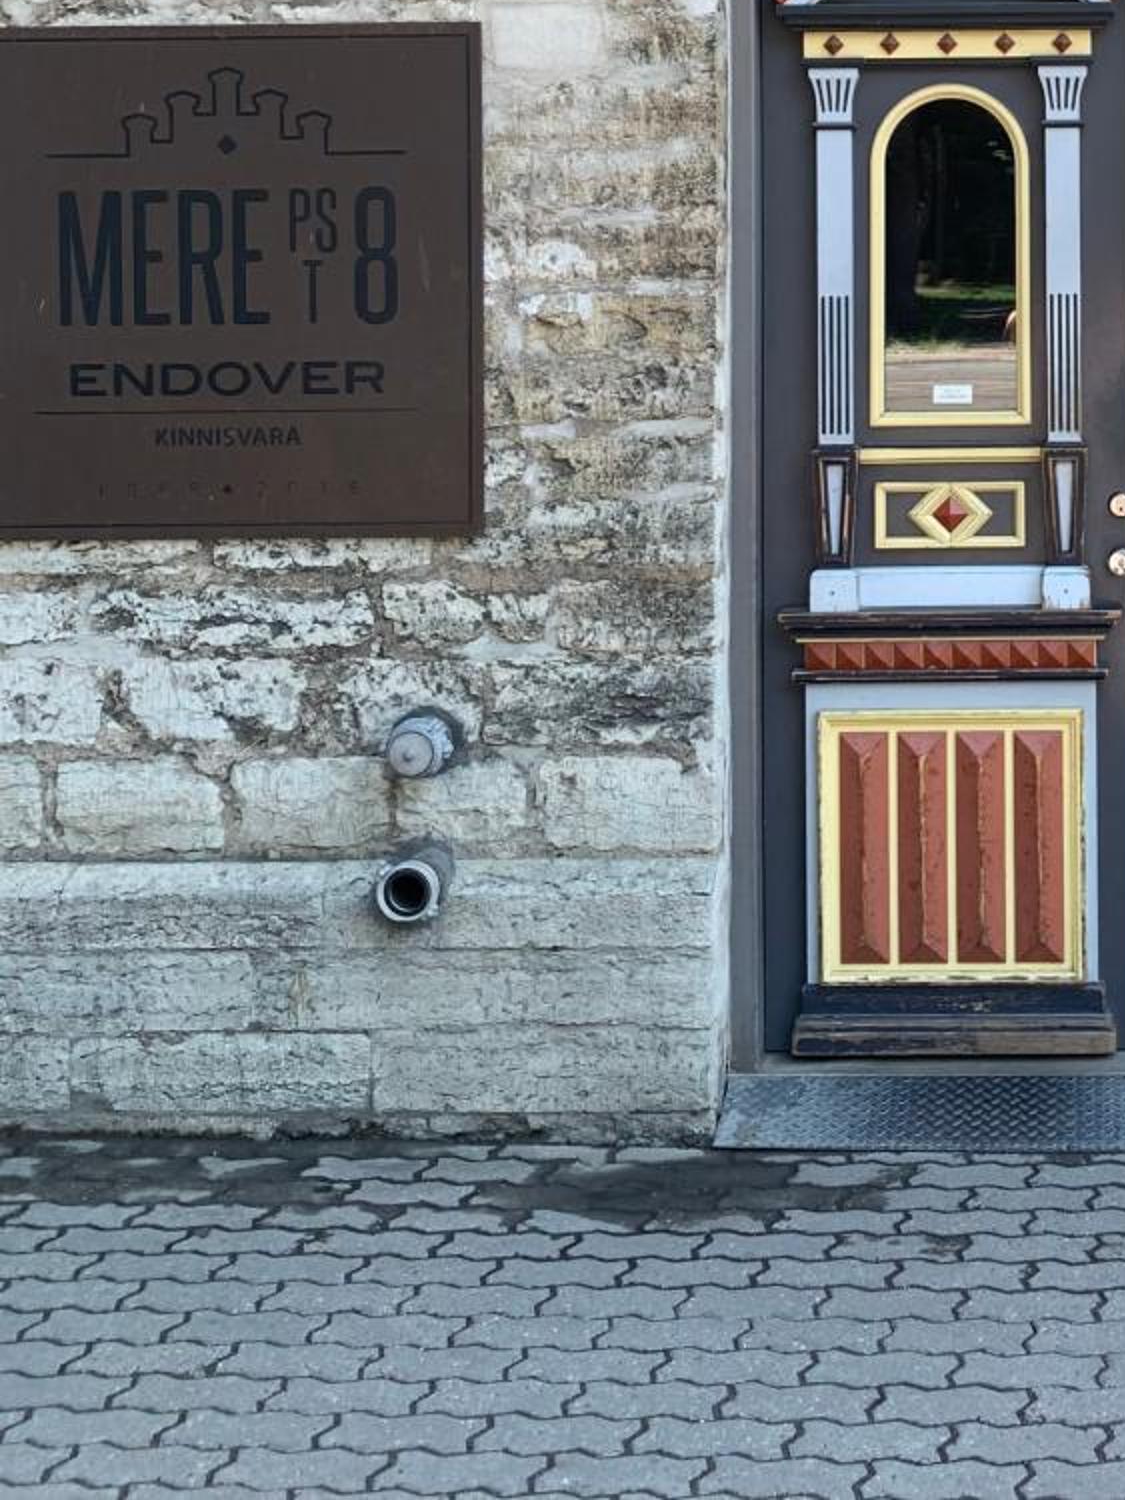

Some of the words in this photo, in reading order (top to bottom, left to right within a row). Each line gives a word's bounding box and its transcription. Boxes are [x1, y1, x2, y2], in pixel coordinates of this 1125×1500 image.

[57, 189, 271, 326] MERE
[353, 186, 399, 325] 8
[69, 361, 386, 398] ENDOVER
[154, 426, 302, 448] KINNISVARA
